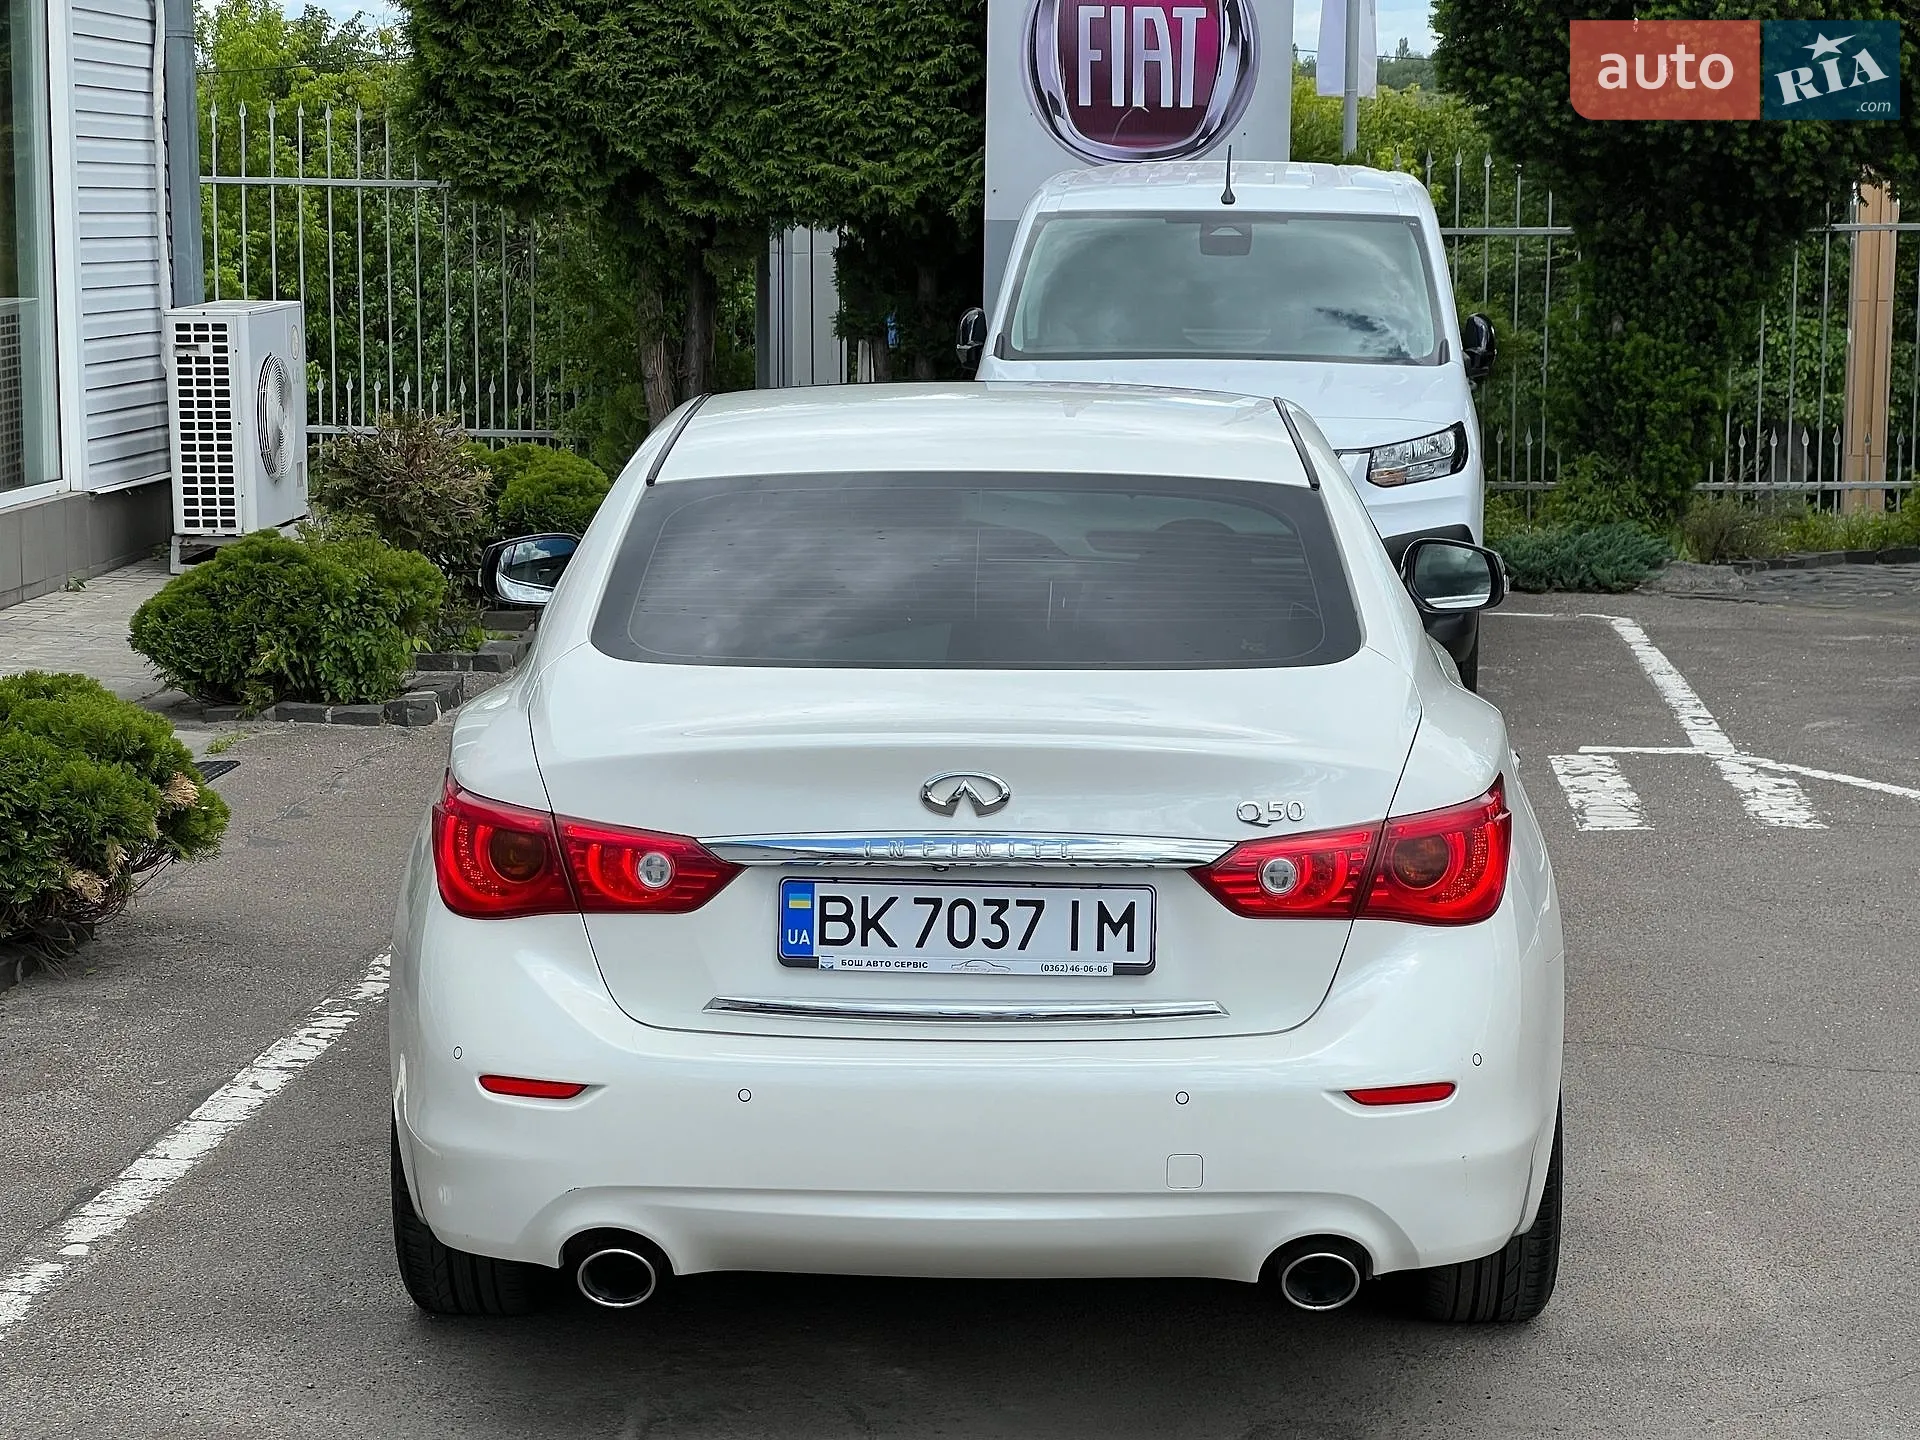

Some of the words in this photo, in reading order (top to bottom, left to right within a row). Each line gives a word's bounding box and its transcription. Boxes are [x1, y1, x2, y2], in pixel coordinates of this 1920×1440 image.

[1077, 5, 1207, 108] FIAT
[1236, 800, 1306, 828] Q50
[863, 840, 1070, 859] INFINITI
[818, 895, 899, 948] BK
[913, 898, 1045, 951] 7037
[1070, 900, 1136, 953] IM
[787, 929, 811, 946] UA
[841, 959, 863, 967] БОШ
[865, 960, 892, 968] АВТО
[893, 961, 929, 969] СЕРВІС
